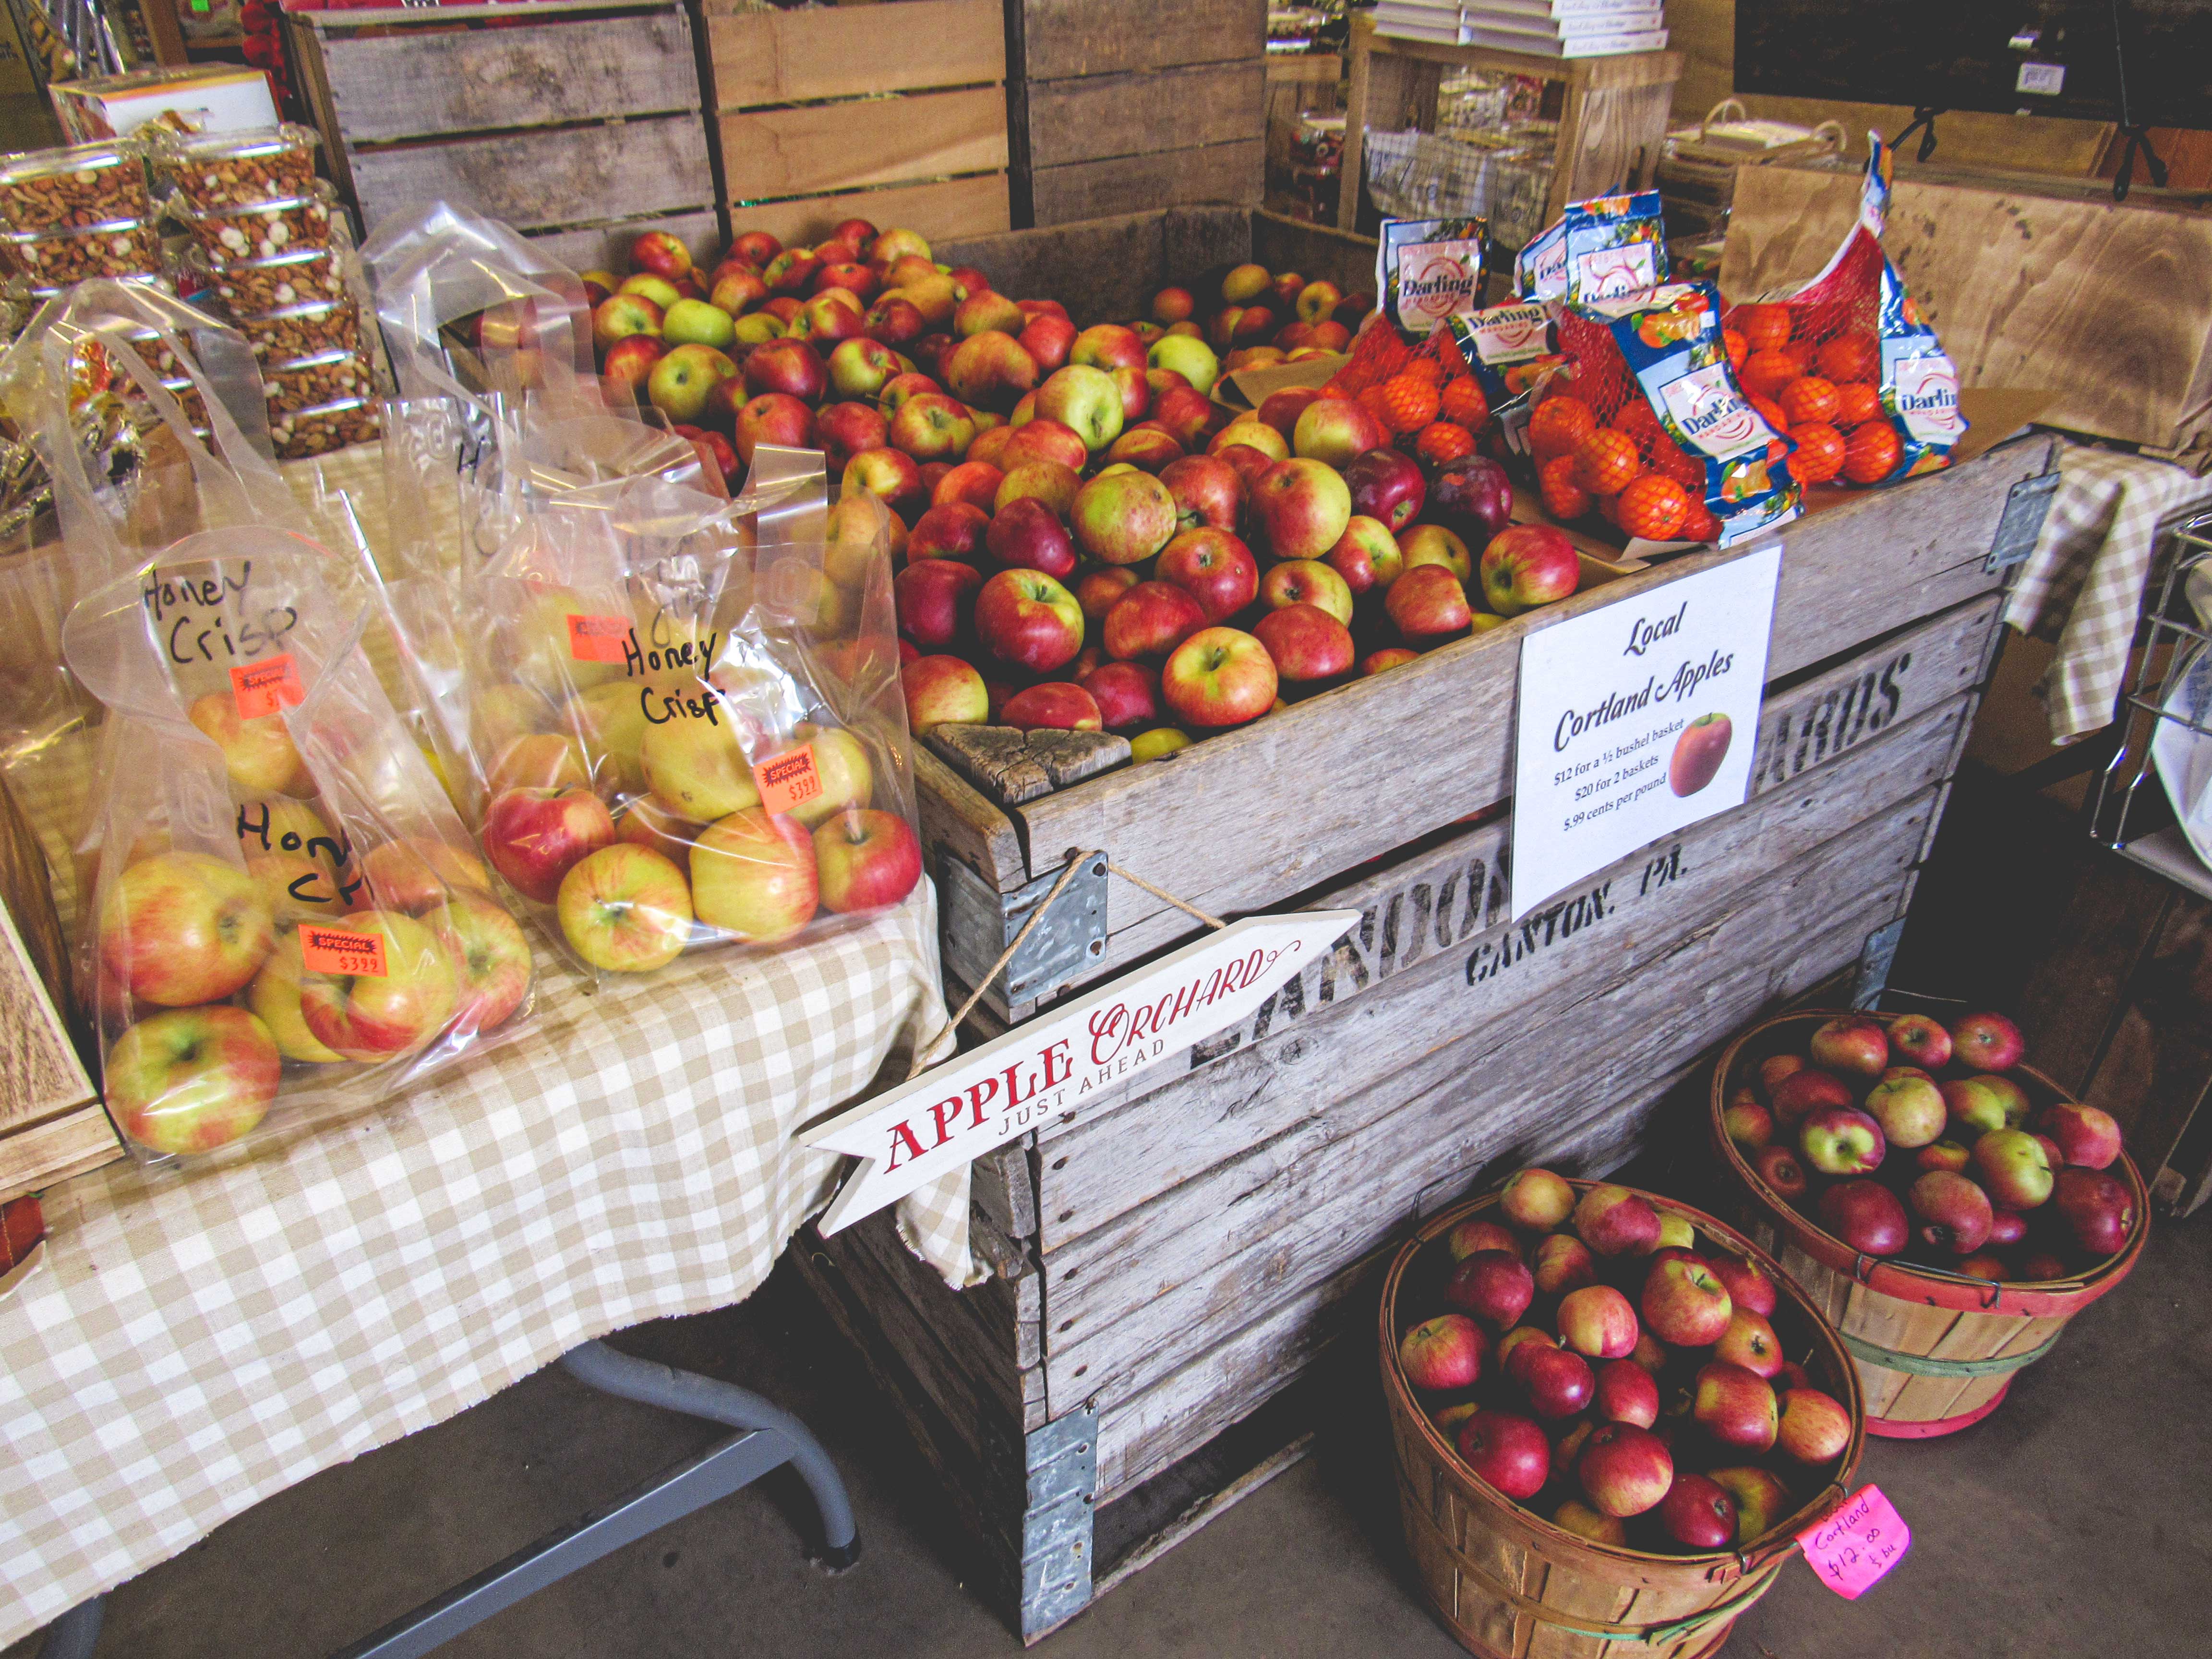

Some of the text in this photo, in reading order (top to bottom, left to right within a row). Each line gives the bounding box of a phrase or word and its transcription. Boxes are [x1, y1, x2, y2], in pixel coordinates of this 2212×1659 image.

[1403, 275, 1474, 297] Darling
[1681, 398, 1750, 435] Darln
[1901, 388, 1956, 410] Darli
[622, 628, 717, 680] Honey
[1623, 601, 1687, 656] Local
[641, 687, 725, 726] Crisp
[1554, 649, 1734, 752] Cortland Apples
[769, 758, 806, 781] SPECIAL
[1554, 768, 1572, 786] $12
[1575, 762, 1590, 776] for
[1593, 760, 1599, 768] a
[1616, 732, 1649, 759] bushel
[1652, 718, 1684, 742] basket
[1575, 755, 1659, 801] $20 for 2 baskets
[1564, 772, 1667, 830] $.99 cents per pound
[237, 803, 353, 867] Hon
[318, 937, 370, 950] SPECIAL
[883, 939, 1301, 1175] APPLE ORCHARD
[998, 1039, 1165, 1136] JUST AHEAD
[1815, 1494, 1869, 1550] Cortland
